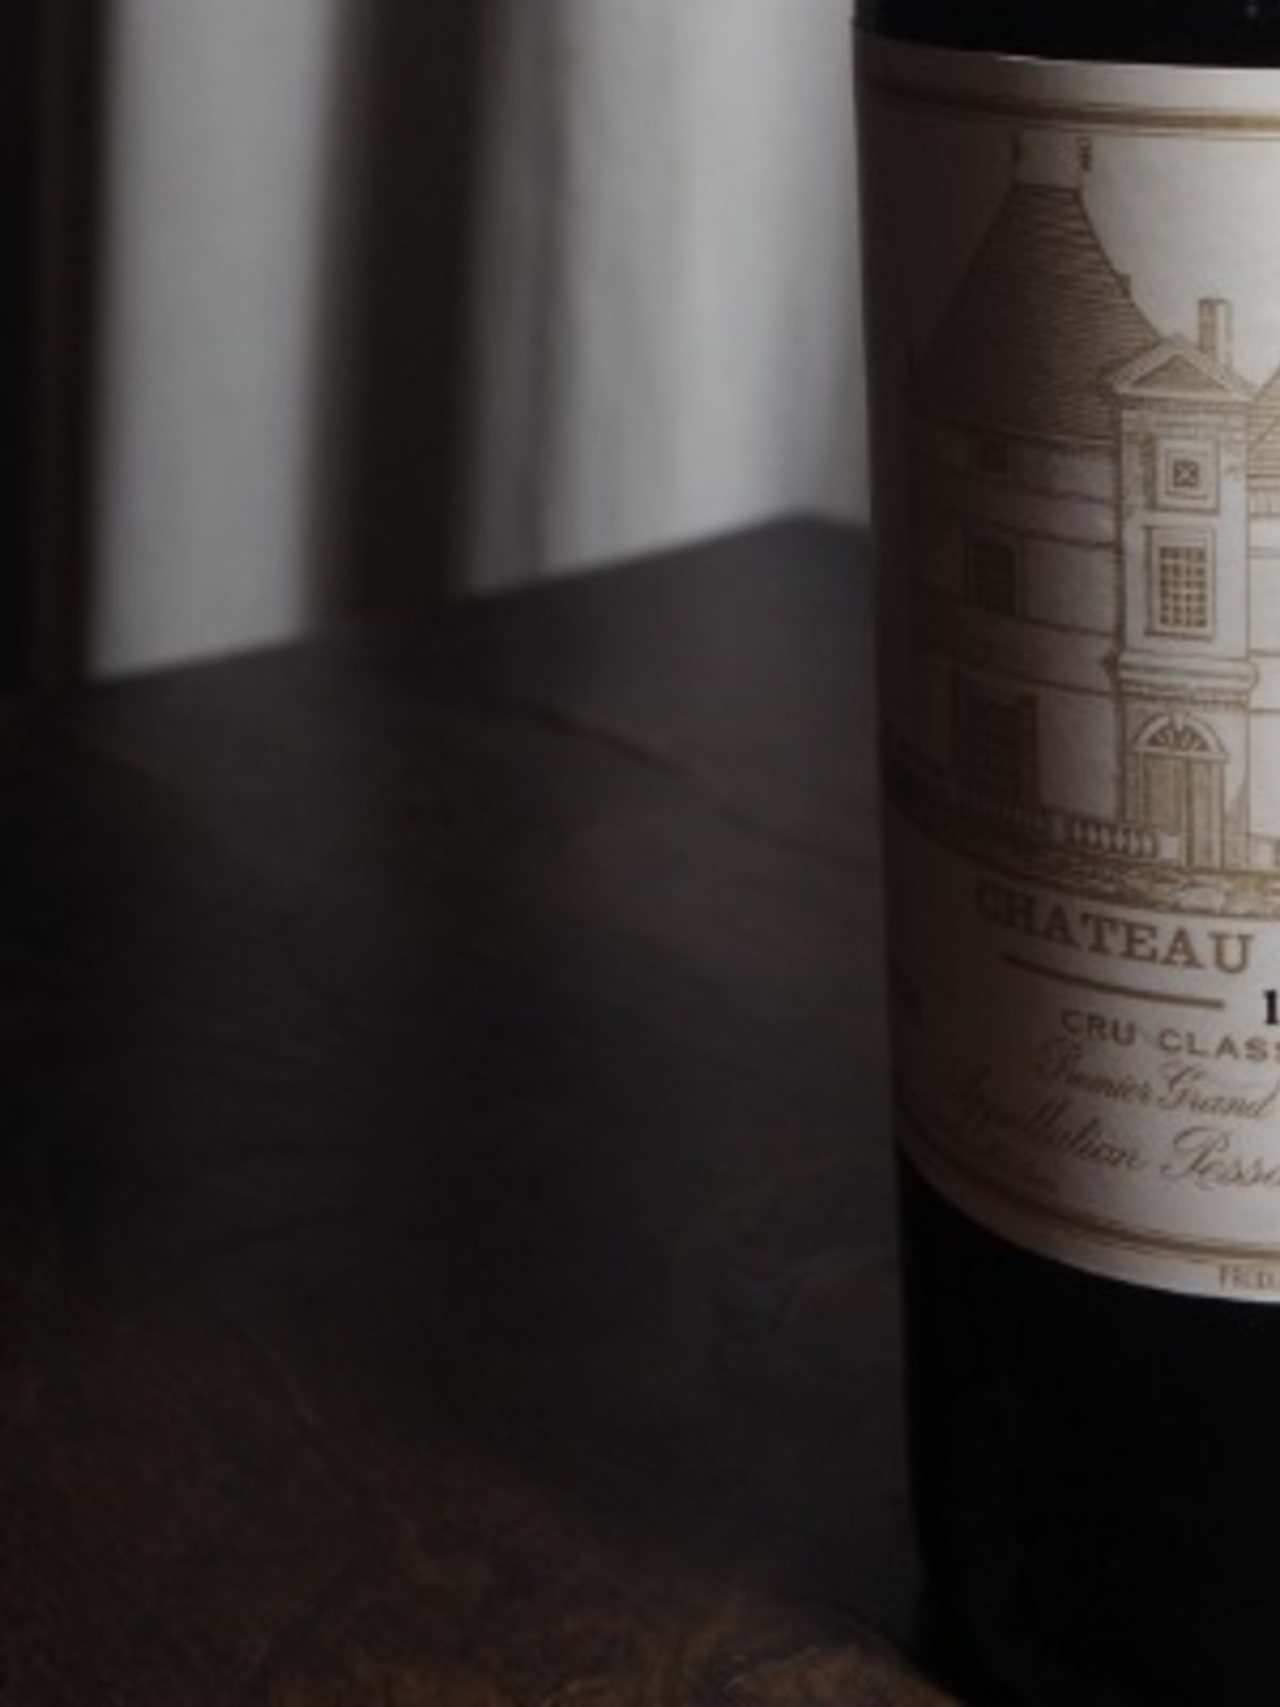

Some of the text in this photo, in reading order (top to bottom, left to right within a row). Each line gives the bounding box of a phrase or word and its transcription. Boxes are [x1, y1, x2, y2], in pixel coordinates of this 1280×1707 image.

[975, 879, 1254, 975] CHATEAU
[1061, 1010, 1136, 1047] CRU
[1156, 1058, 1280, 1119] Grand
